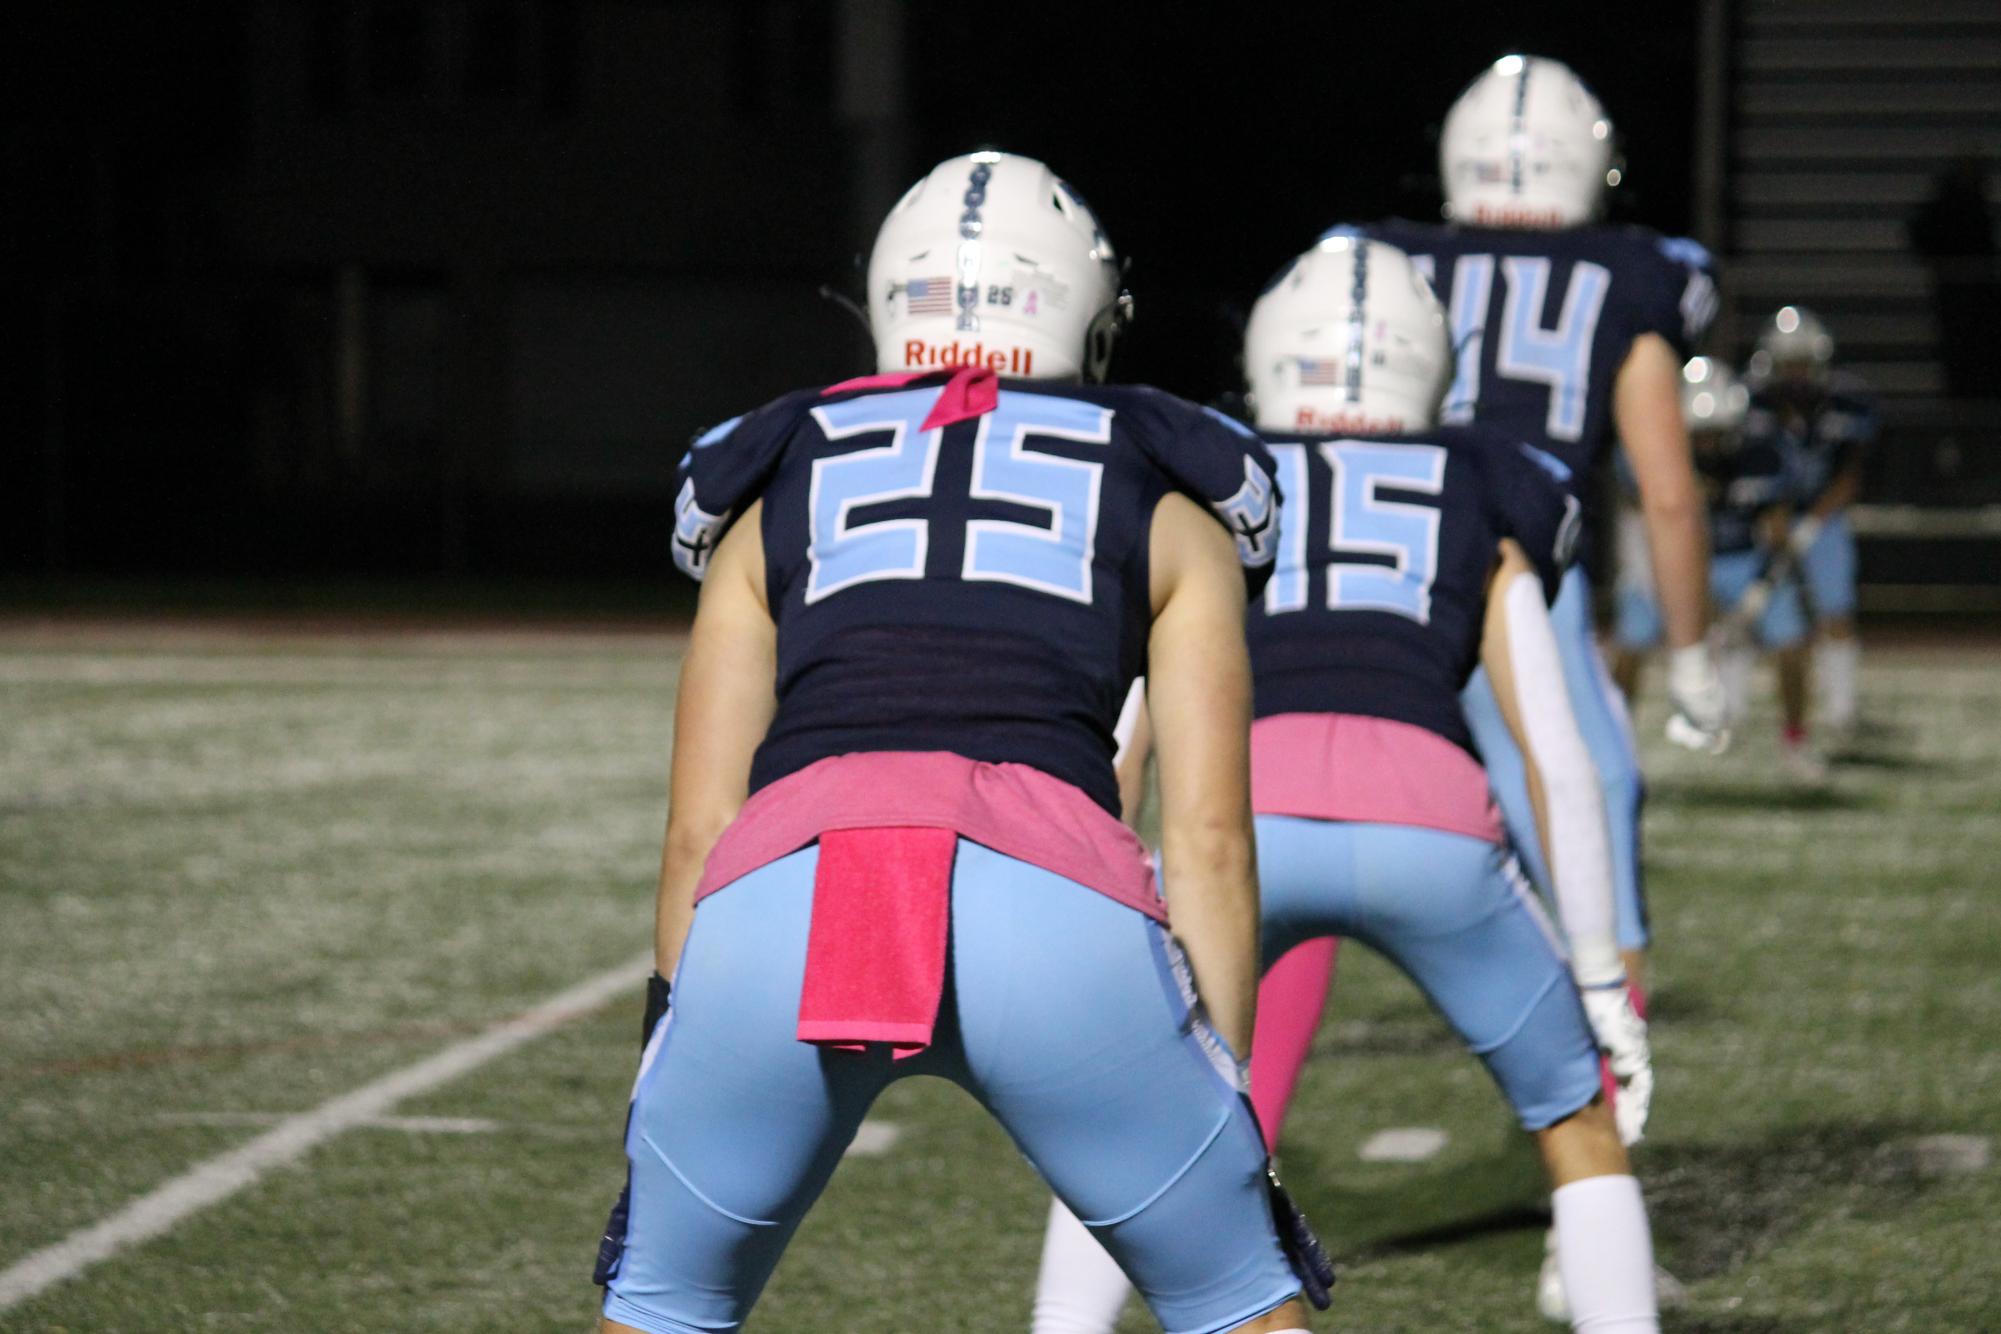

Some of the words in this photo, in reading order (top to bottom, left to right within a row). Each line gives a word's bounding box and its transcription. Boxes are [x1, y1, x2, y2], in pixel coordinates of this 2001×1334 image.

[988, 286, 1013, 305] 25
[905, 339, 1033, 376] Riddell
[804, 385, 1115, 605] 25
[1264, 439, 1447, 626] 15
